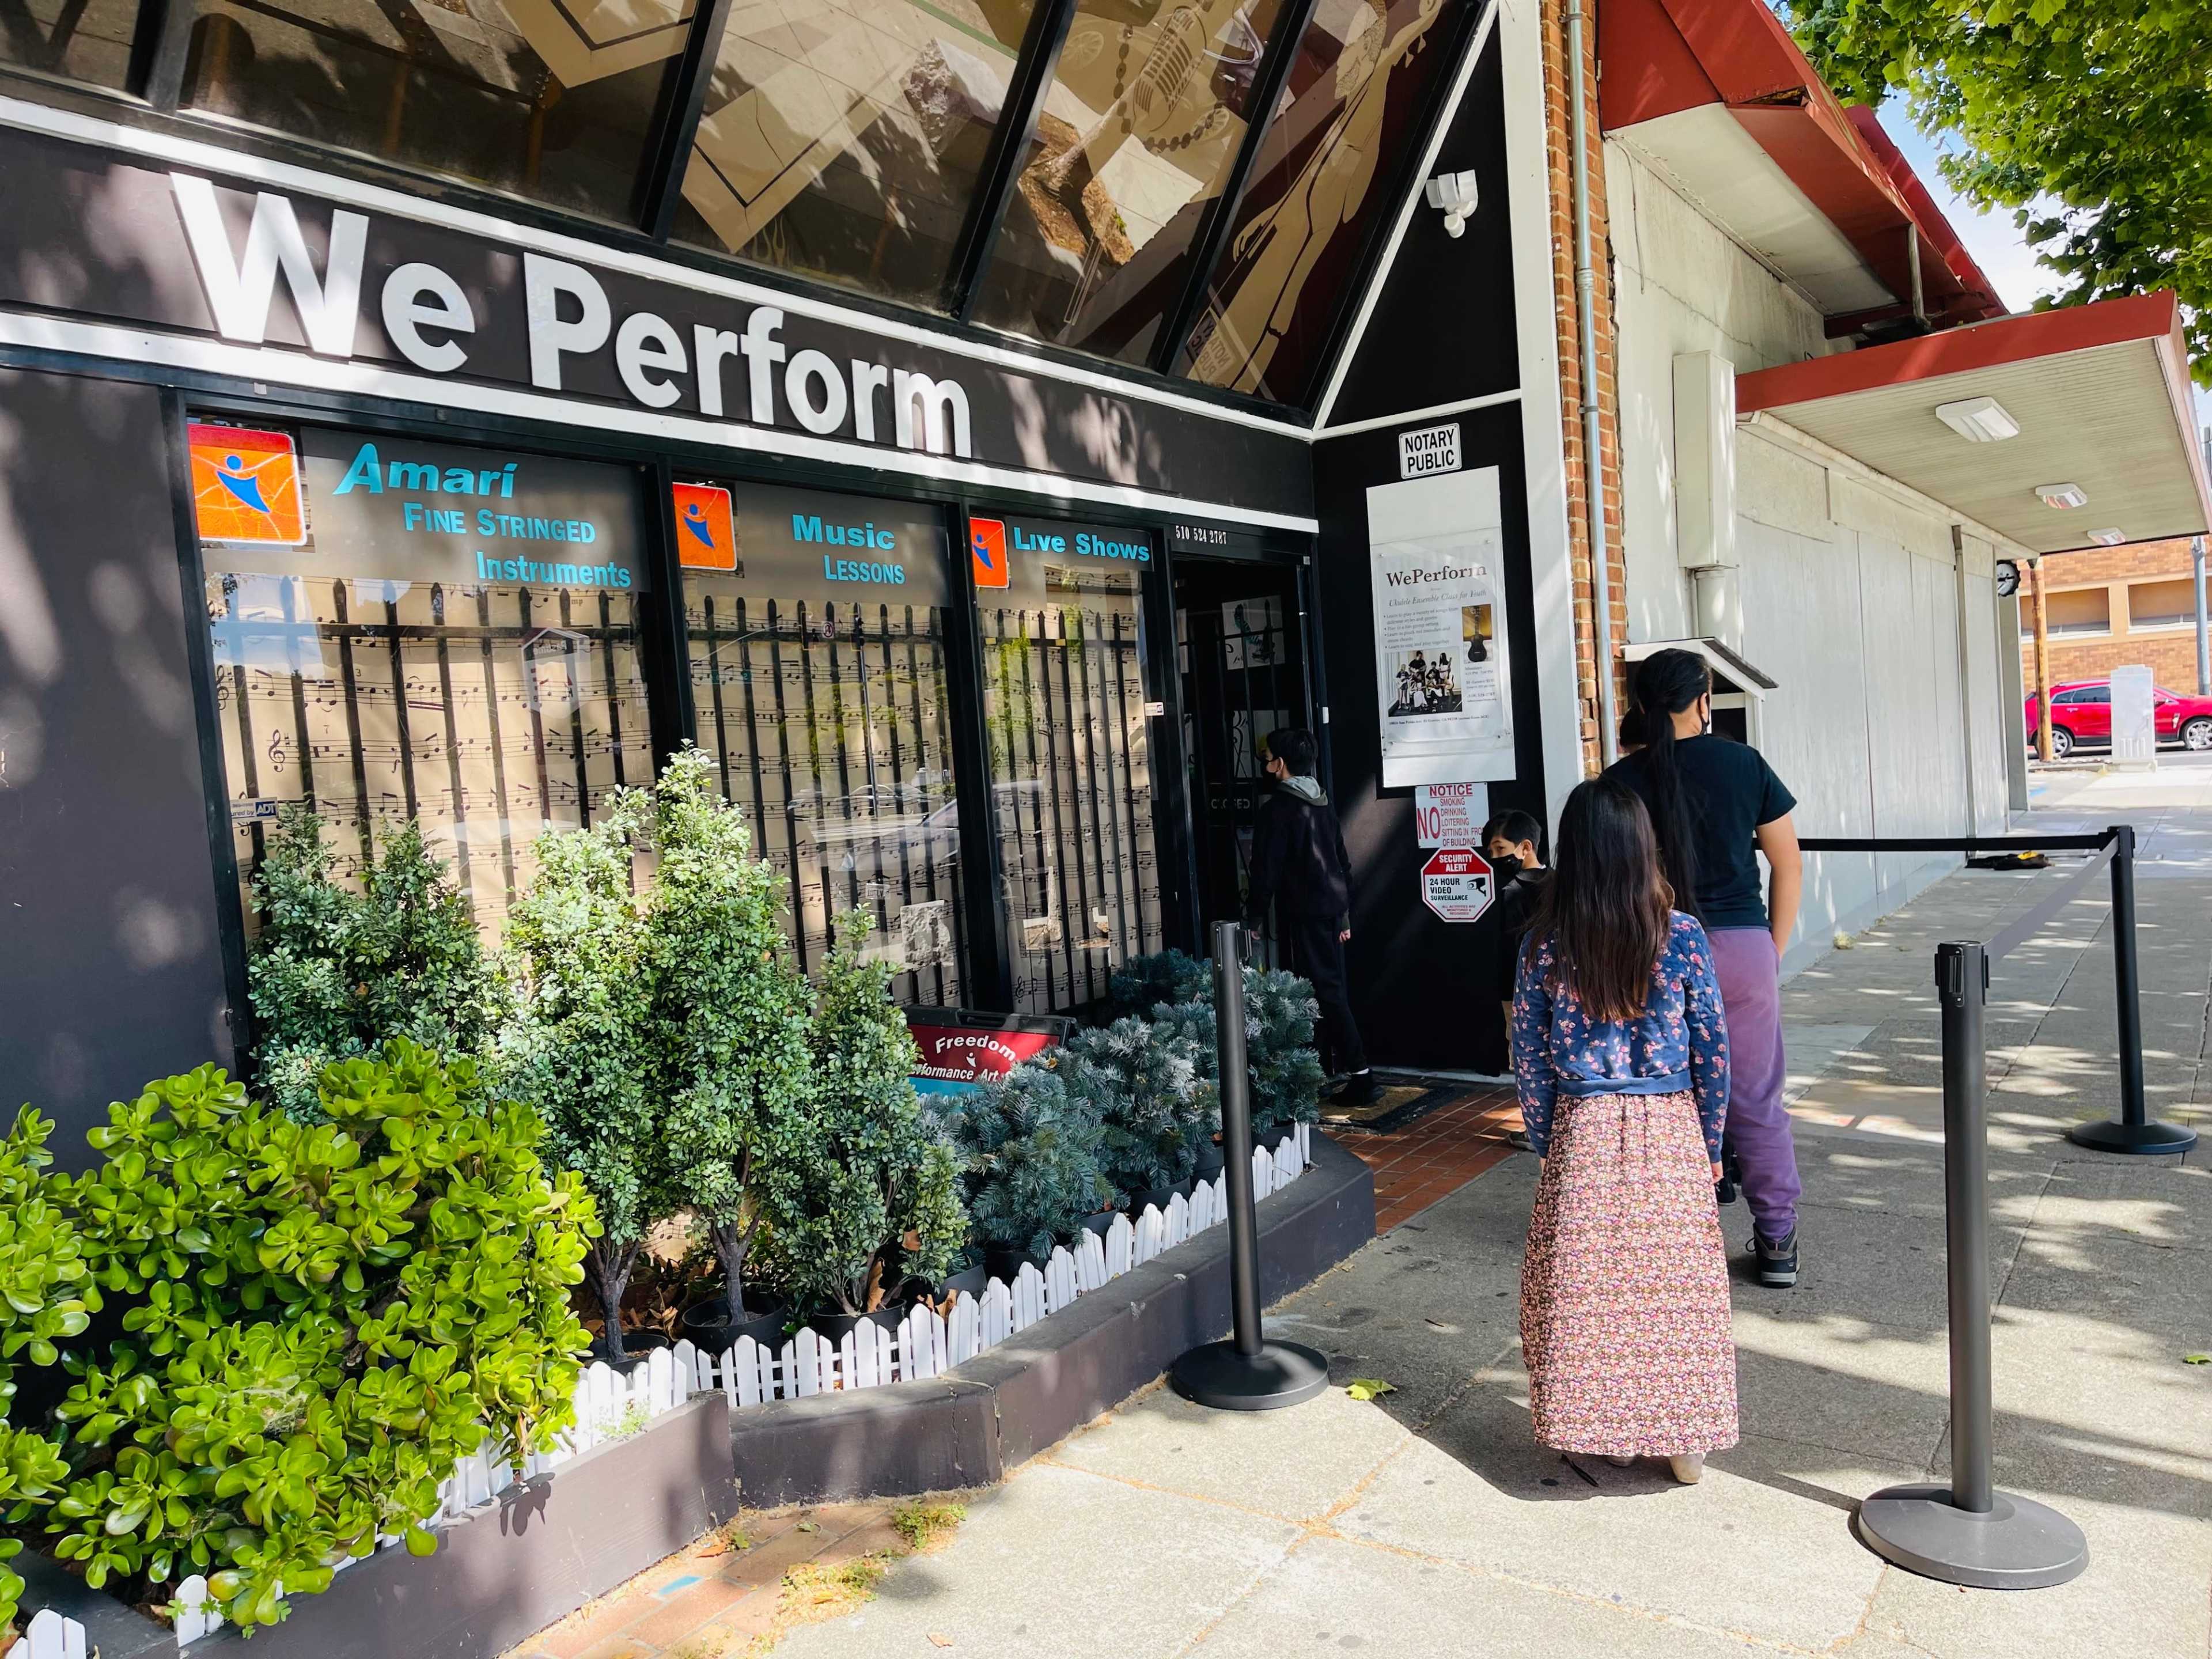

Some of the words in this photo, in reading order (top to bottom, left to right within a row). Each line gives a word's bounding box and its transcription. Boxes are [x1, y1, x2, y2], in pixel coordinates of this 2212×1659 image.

[169, 172, 475, 373] We
[522, 252, 971, 459] Perform
[1405, 429, 1455, 453] NOTARY
[1408, 449, 1455, 473] PUBLIC
[403, 502, 467, 534] FINE
[477, 508, 596, 543] STRINGED
[792, 514, 895, 550] Music
[1176, 525, 1190, 540] 510
[1194, 528, 1207, 542] 524
[1209, 529, 1226, 544] 2787
[1075, 532, 1150, 562] Shows
[476, 551, 632, 588] Instruments
[824, 555, 906, 585] LESSONS
[1386, 566, 1487, 587] WePerform
[1412, 594, 1439, 604] Ensemble
[1460, 590, 1468, 599] for
[1470, 589, 1486, 597] Youth
[1430, 784, 1473, 796] NOTICE
[257, 803, 276, 815] ADT
[1440, 797, 1465, 806] SMOKING
[1441, 807, 1467, 816] DRINKING
[1417, 806, 1441, 839] NO
[1441, 817, 1469, 826] LOITERING
[1442, 828, 1462, 836] SITTING
[1471, 827, 1484, 835] FRO
[1450, 838, 1476, 846] BUILDING
[1439, 854, 1473, 863] SECURITY
[1445, 863, 1467, 872] ALERT
[935, 1035, 1016, 1061] Freedom
